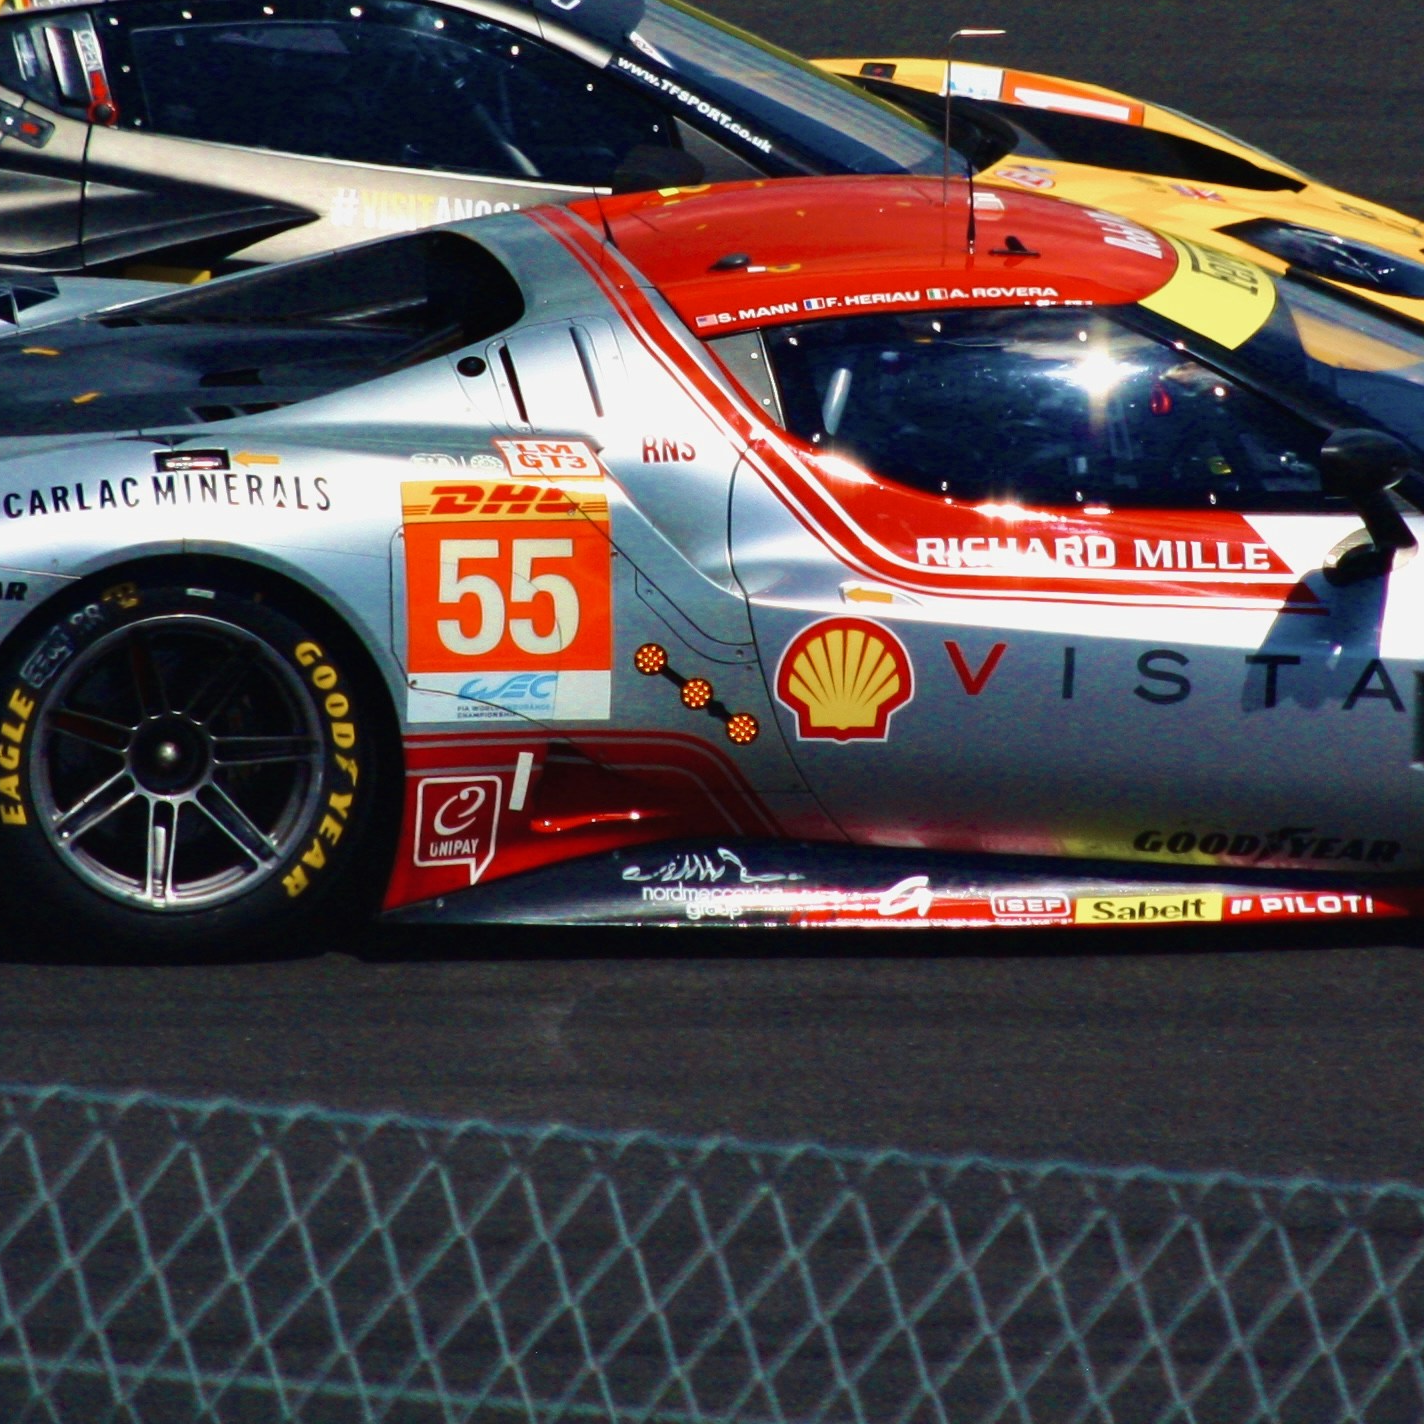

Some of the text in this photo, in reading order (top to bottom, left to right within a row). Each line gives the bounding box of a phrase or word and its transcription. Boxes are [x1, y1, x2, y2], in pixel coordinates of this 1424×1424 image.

[617, 56, 773, 154] www.TFSPORT.co.uk
[825, 290, 920, 308] F. HERIAU
[948, 286, 1059, 299] A. ROVERA
[717, 302, 798, 324] S. MANN
[514, 443, 574, 455] LM
[516, 454, 588, 470] GT3
[3, 473, 332, 519] CARLAC MINERALS
[429, 484, 581, 515] DHL
[916, 536, 1271, 571] RICHARD MILLE
[436, 538, 580, 656] 55
[458, 673, 558, 699] WEC
[943, 639, 1406, 713] VISTA
[429, 837, 480, 858] UNIPAY
[998, 898, 1064, 913] ISEF
[1092, 897, 1208, 921] Sabelt
[1259, 895, 1375, 915] PILOTI
